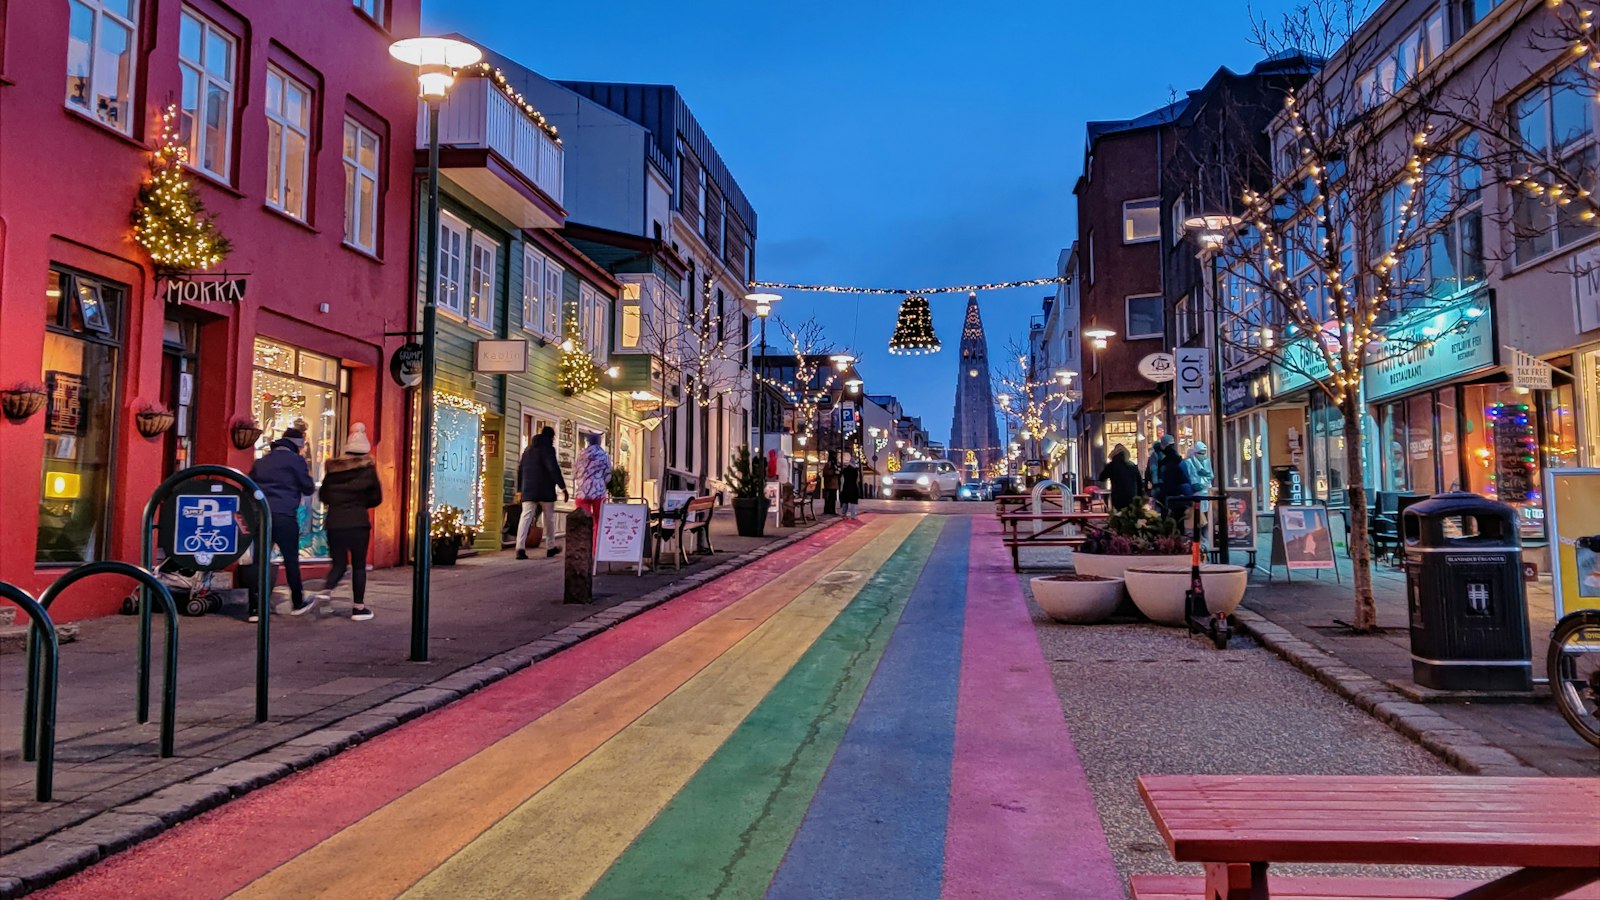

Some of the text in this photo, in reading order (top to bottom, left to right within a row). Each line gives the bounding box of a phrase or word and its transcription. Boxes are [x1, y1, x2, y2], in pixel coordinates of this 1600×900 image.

[167, 280, 243, 305] MOKKA
[400, 350, 423, 360] GRUMP
[483, 351, 520, 361] Kaolin
[1376, 344, 1396, 375] FISH
[1390, 365, 1422, 385] RESTAURANT
[1517, 368, 1548, 377] TAX FREE
[1517, 376, 1548, 384] SHOPPING
[843, 410, 850, 420] P
[1290, 471, 1302, 506] label
[197, 499, 219, 526] P
